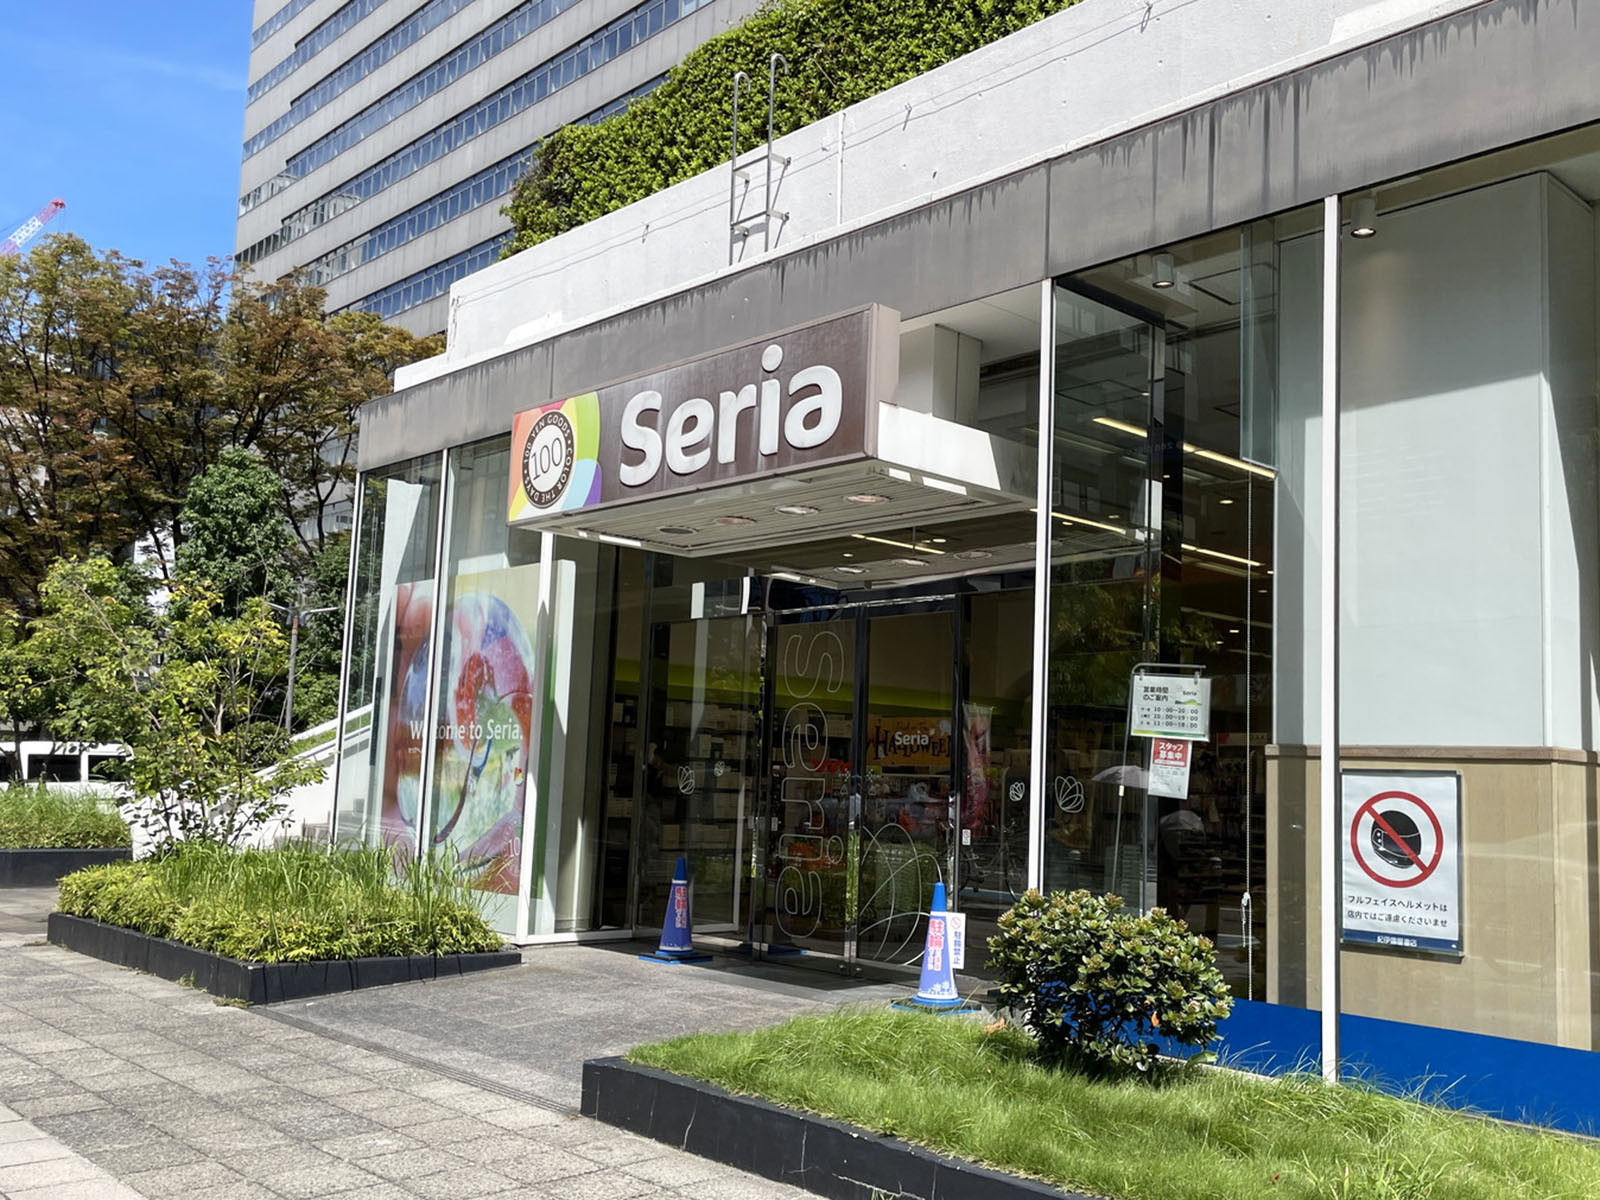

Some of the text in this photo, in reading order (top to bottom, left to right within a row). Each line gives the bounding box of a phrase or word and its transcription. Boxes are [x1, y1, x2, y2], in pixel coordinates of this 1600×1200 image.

[530, 417, 546, 438] YEN
[546, 413, 571, 438] GOODS
[619, 343, 843, 488] Seria
[531, 437, 563, 480] 100
[556, 447, 574, 491] COLOR
[523, 475, 541, 502] DAYS
[469, 721, 483, 740] to
[486, 717, 523, 740] Seria.
[894, 730, 930, 746] Seria
[775, 631, 845, 938] Seria
[1348, 895, 1448, 912] フルフェイスヘルメットは
